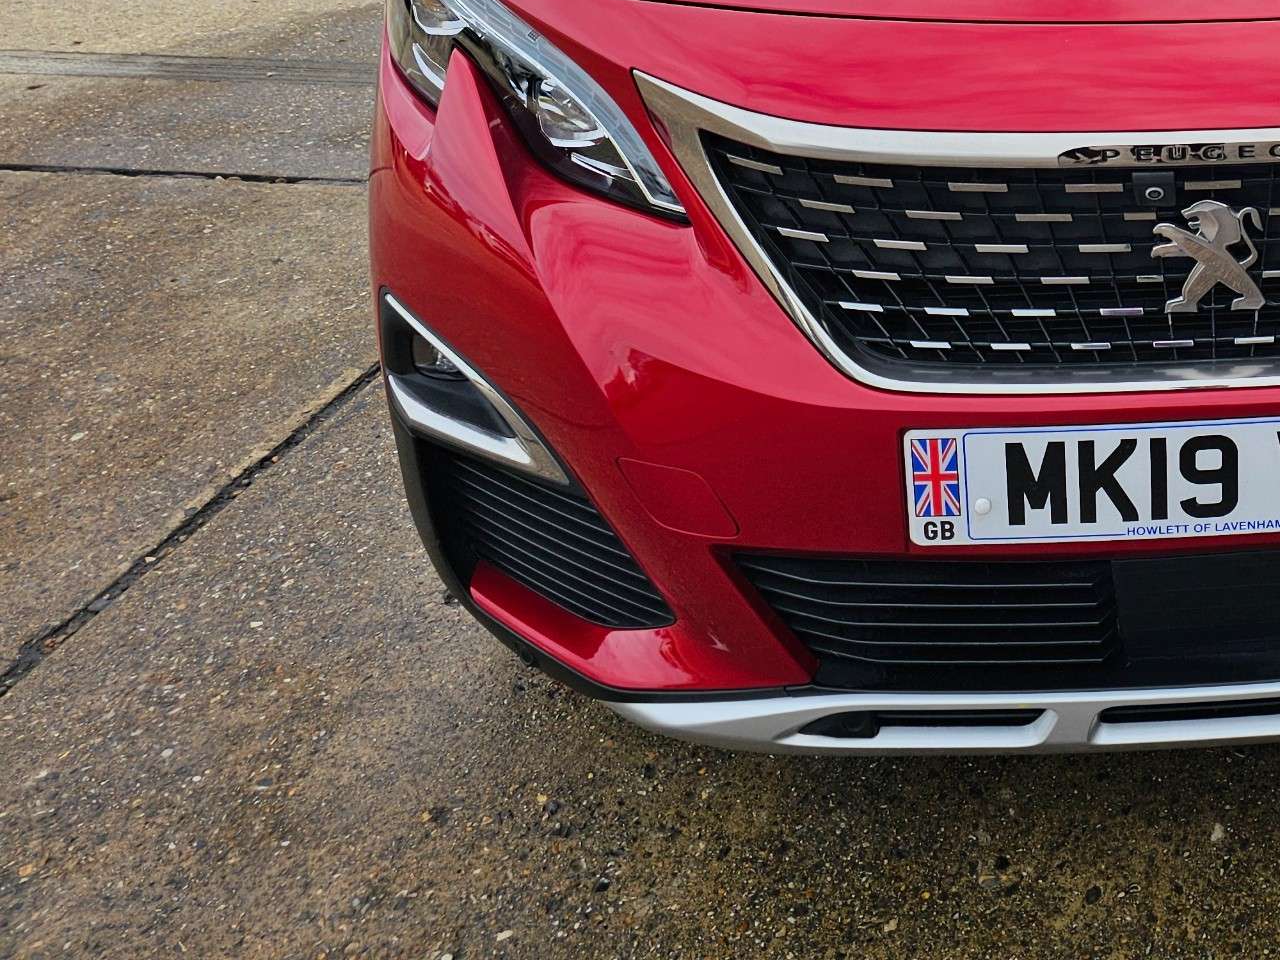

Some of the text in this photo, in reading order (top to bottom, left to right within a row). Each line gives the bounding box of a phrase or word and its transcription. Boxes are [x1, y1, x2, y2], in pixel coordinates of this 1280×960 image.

[1005, 434, 1239, 526] MK19
[923, 521, 955, 540] GB
[1127, 524, 1190, 536] HOWLETT
[1193, 523, 1211, 533] OF
